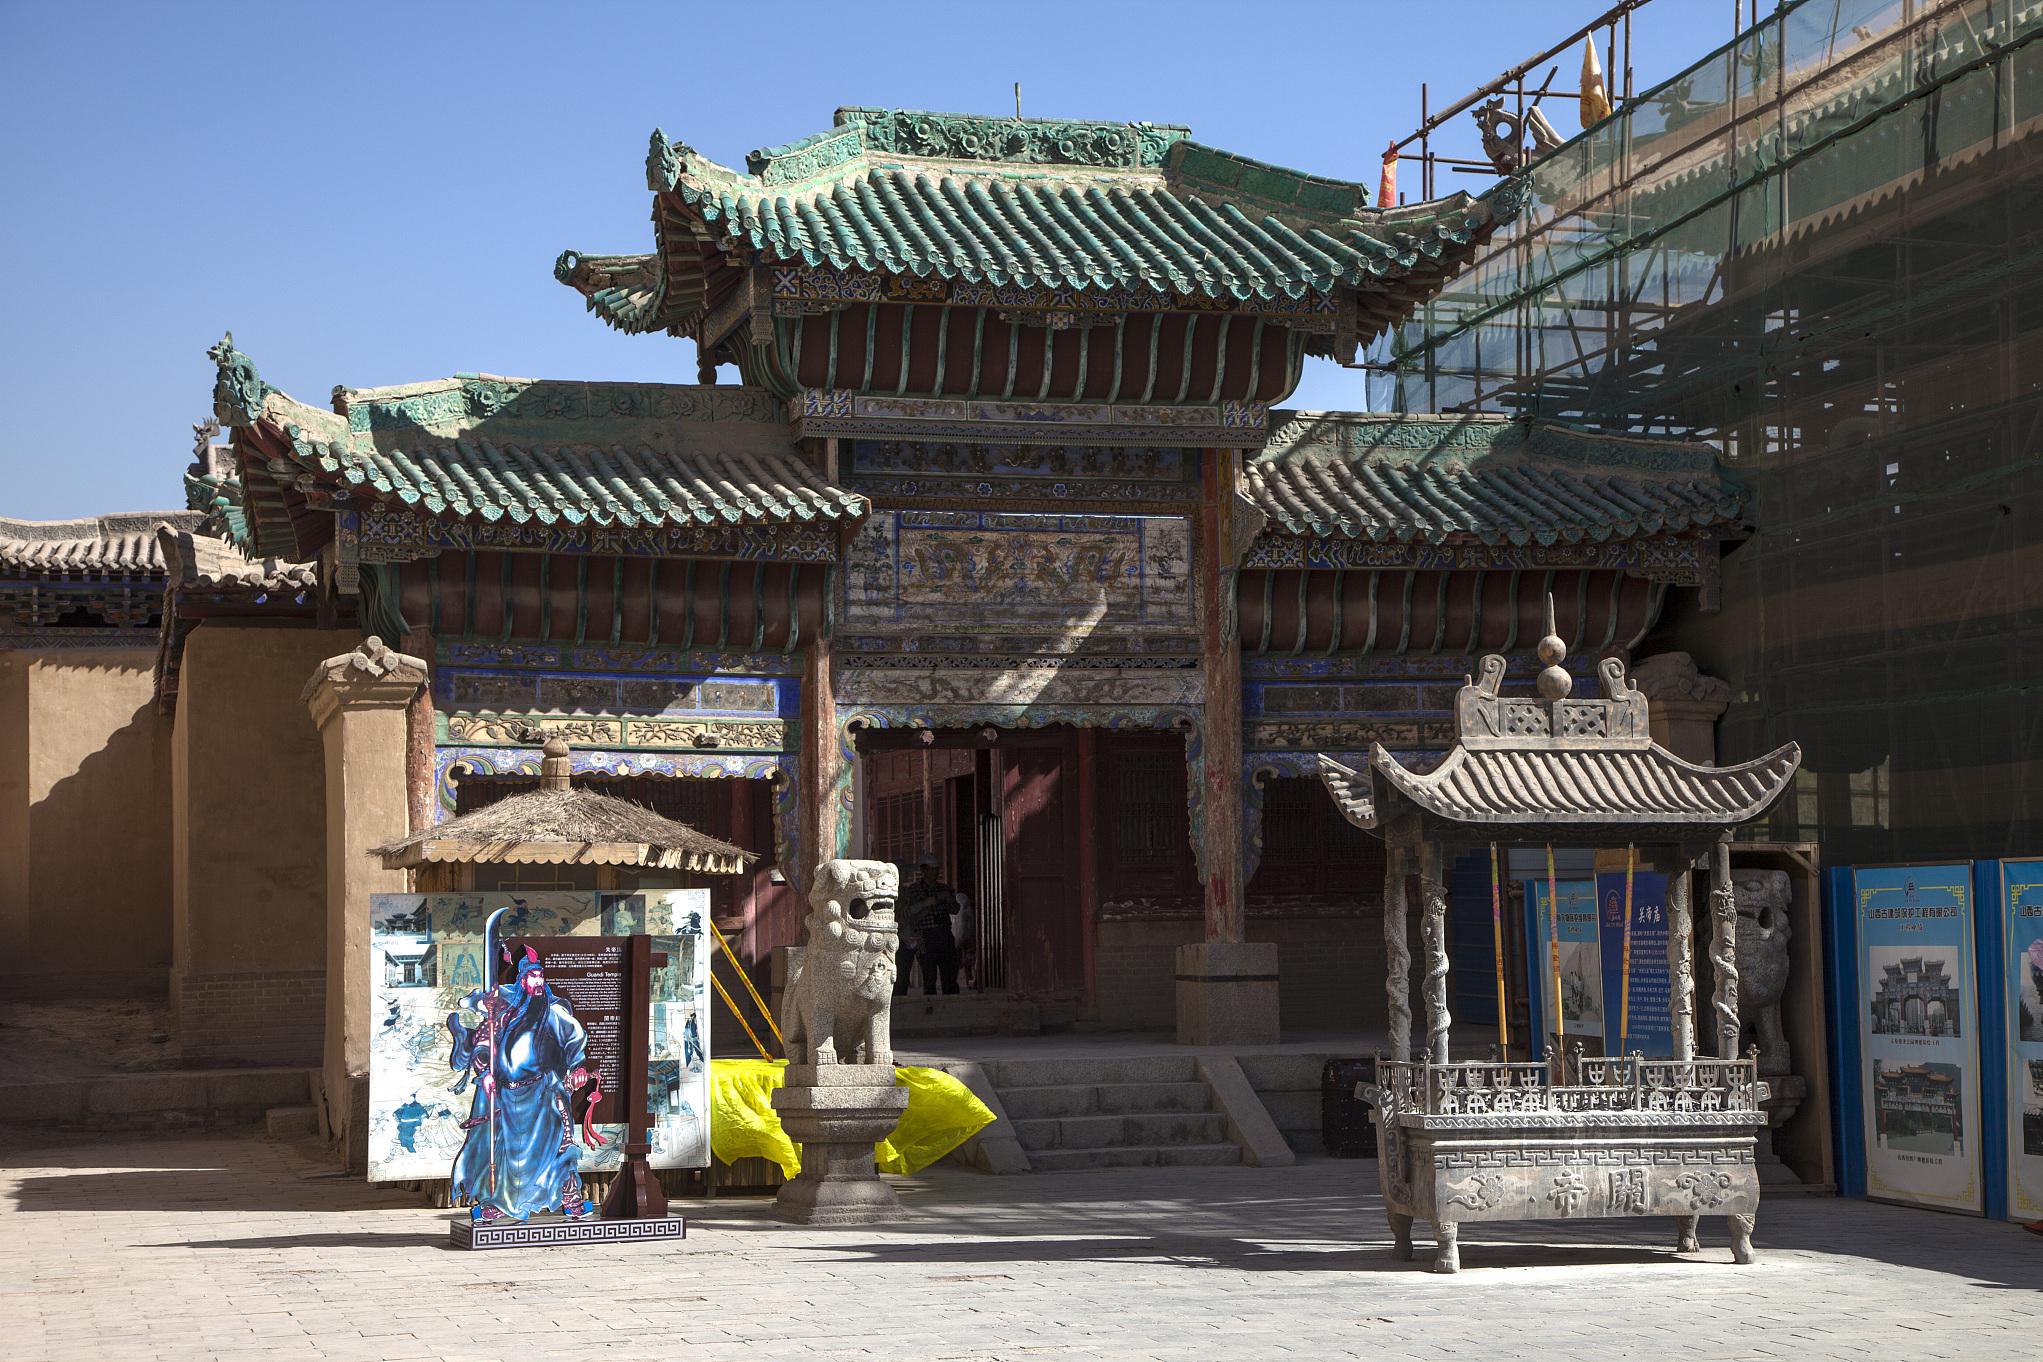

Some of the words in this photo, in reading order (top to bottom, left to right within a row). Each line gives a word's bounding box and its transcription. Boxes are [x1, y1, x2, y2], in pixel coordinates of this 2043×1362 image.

[1638, 905, 1661, 924] 关帝庙
[1868, 906, 1958, 919] 山西古建筑保护工程有限公司
[2019, 905, 2043, 917] 山西古
